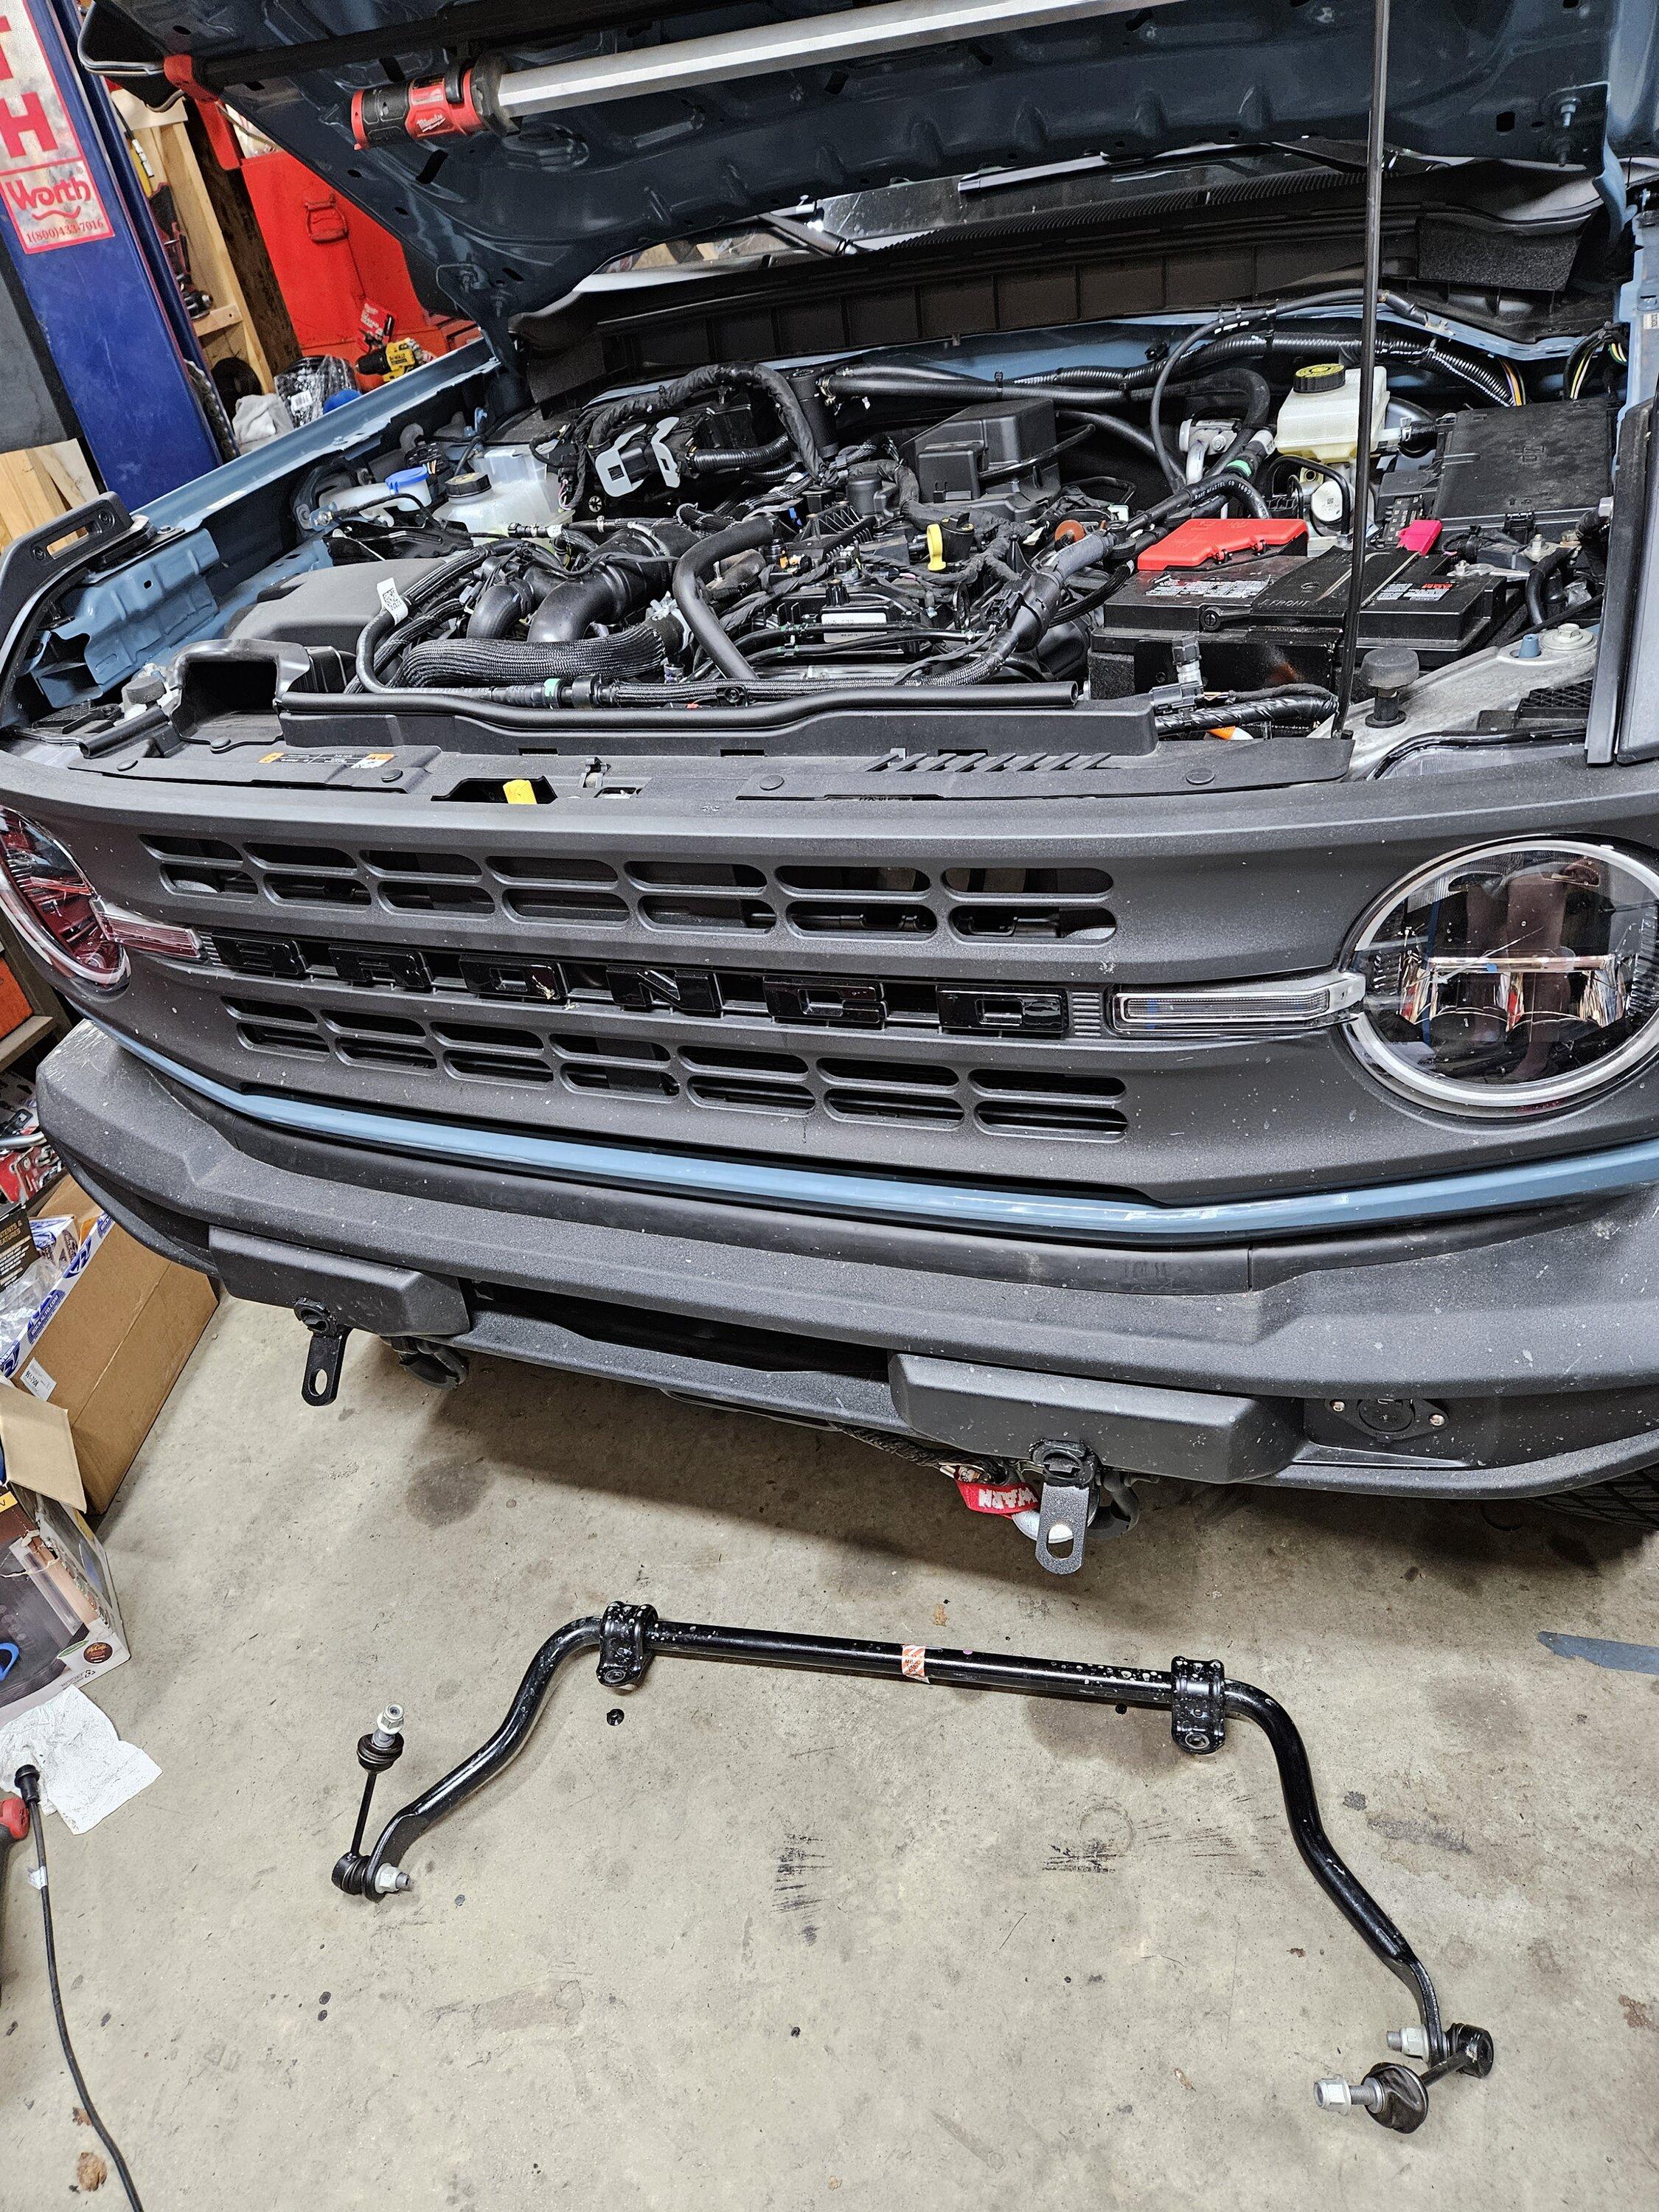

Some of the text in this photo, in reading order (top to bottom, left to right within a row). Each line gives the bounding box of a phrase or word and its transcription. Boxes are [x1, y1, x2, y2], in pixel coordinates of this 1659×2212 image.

[7, 176, 92, 211] Worth
[1269, 599, 1310, 607] FRONT
[212, 931, 1069, 1034] BRONCO
[978, 1486, 1039, 1509] WARN
